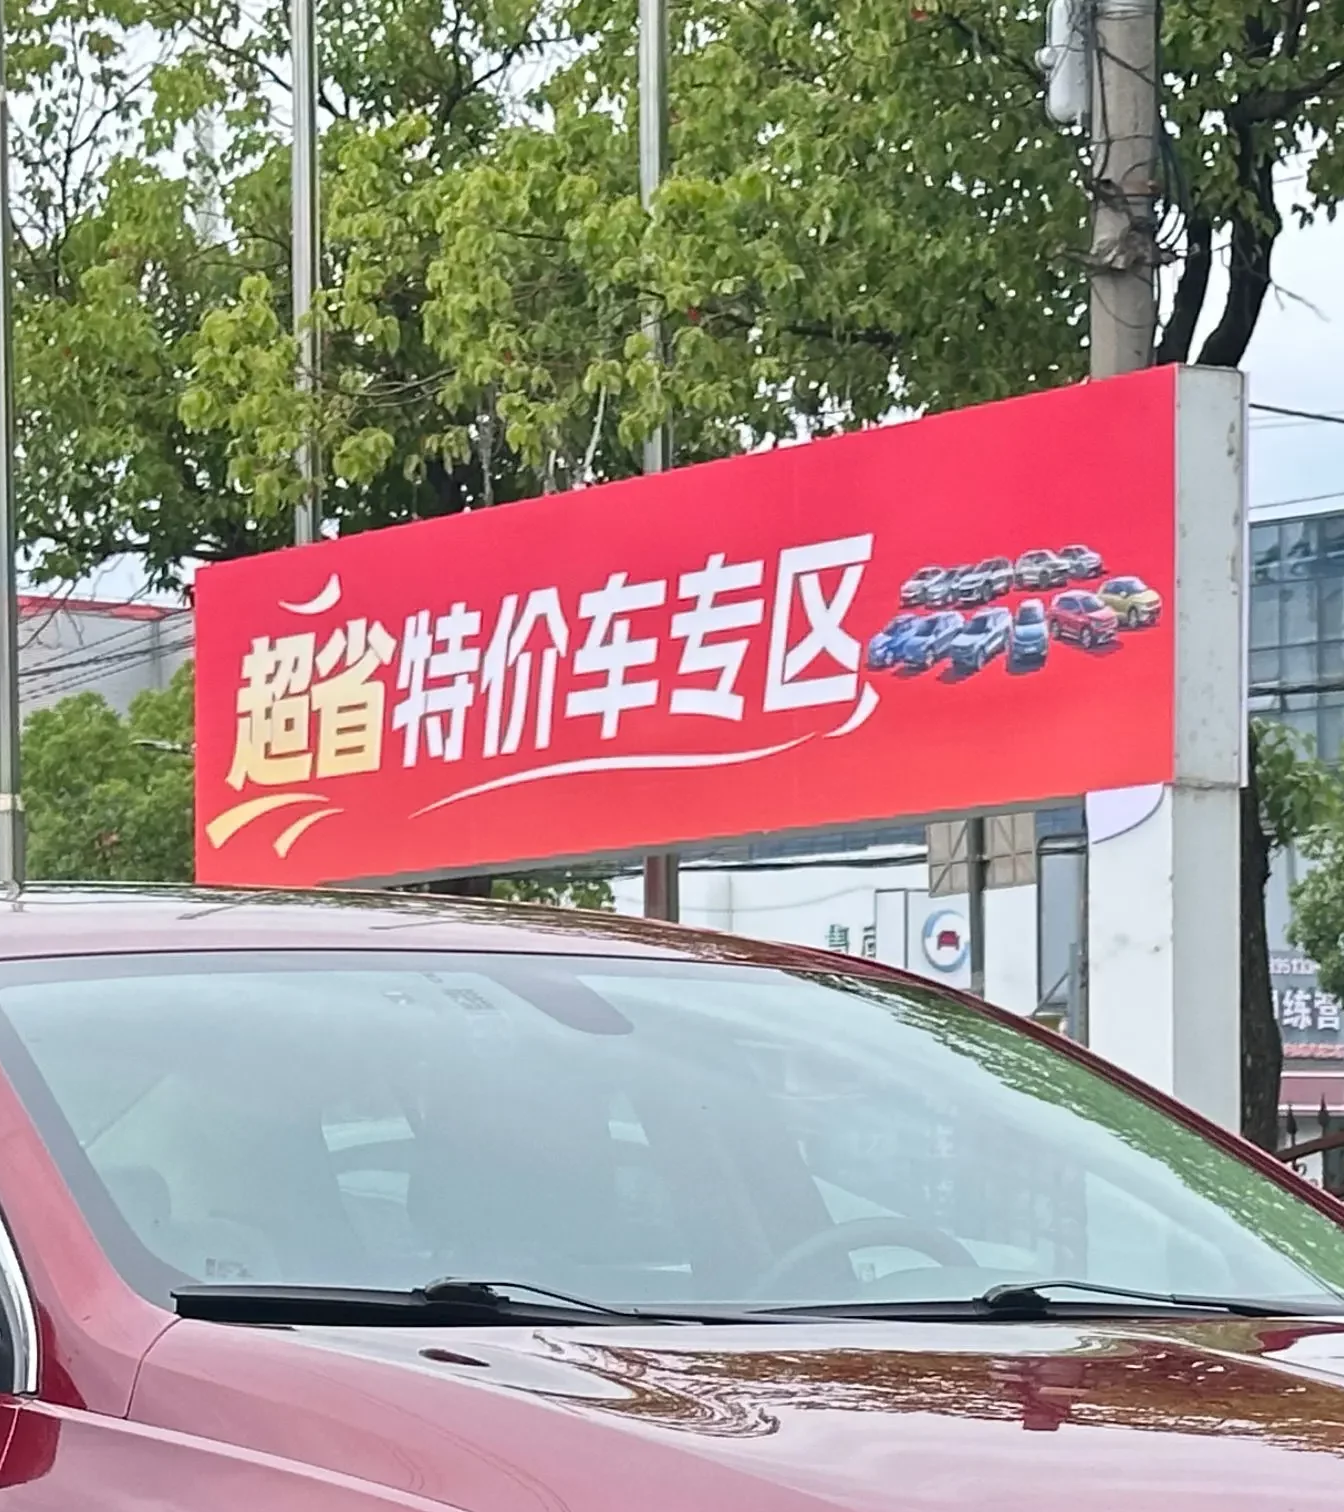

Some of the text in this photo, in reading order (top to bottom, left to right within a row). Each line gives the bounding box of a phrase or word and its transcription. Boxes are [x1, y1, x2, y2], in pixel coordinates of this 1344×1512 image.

[225, 532, 873, 791] 超省特价车专区
[1271, 989, 1341, 1030] 练营
